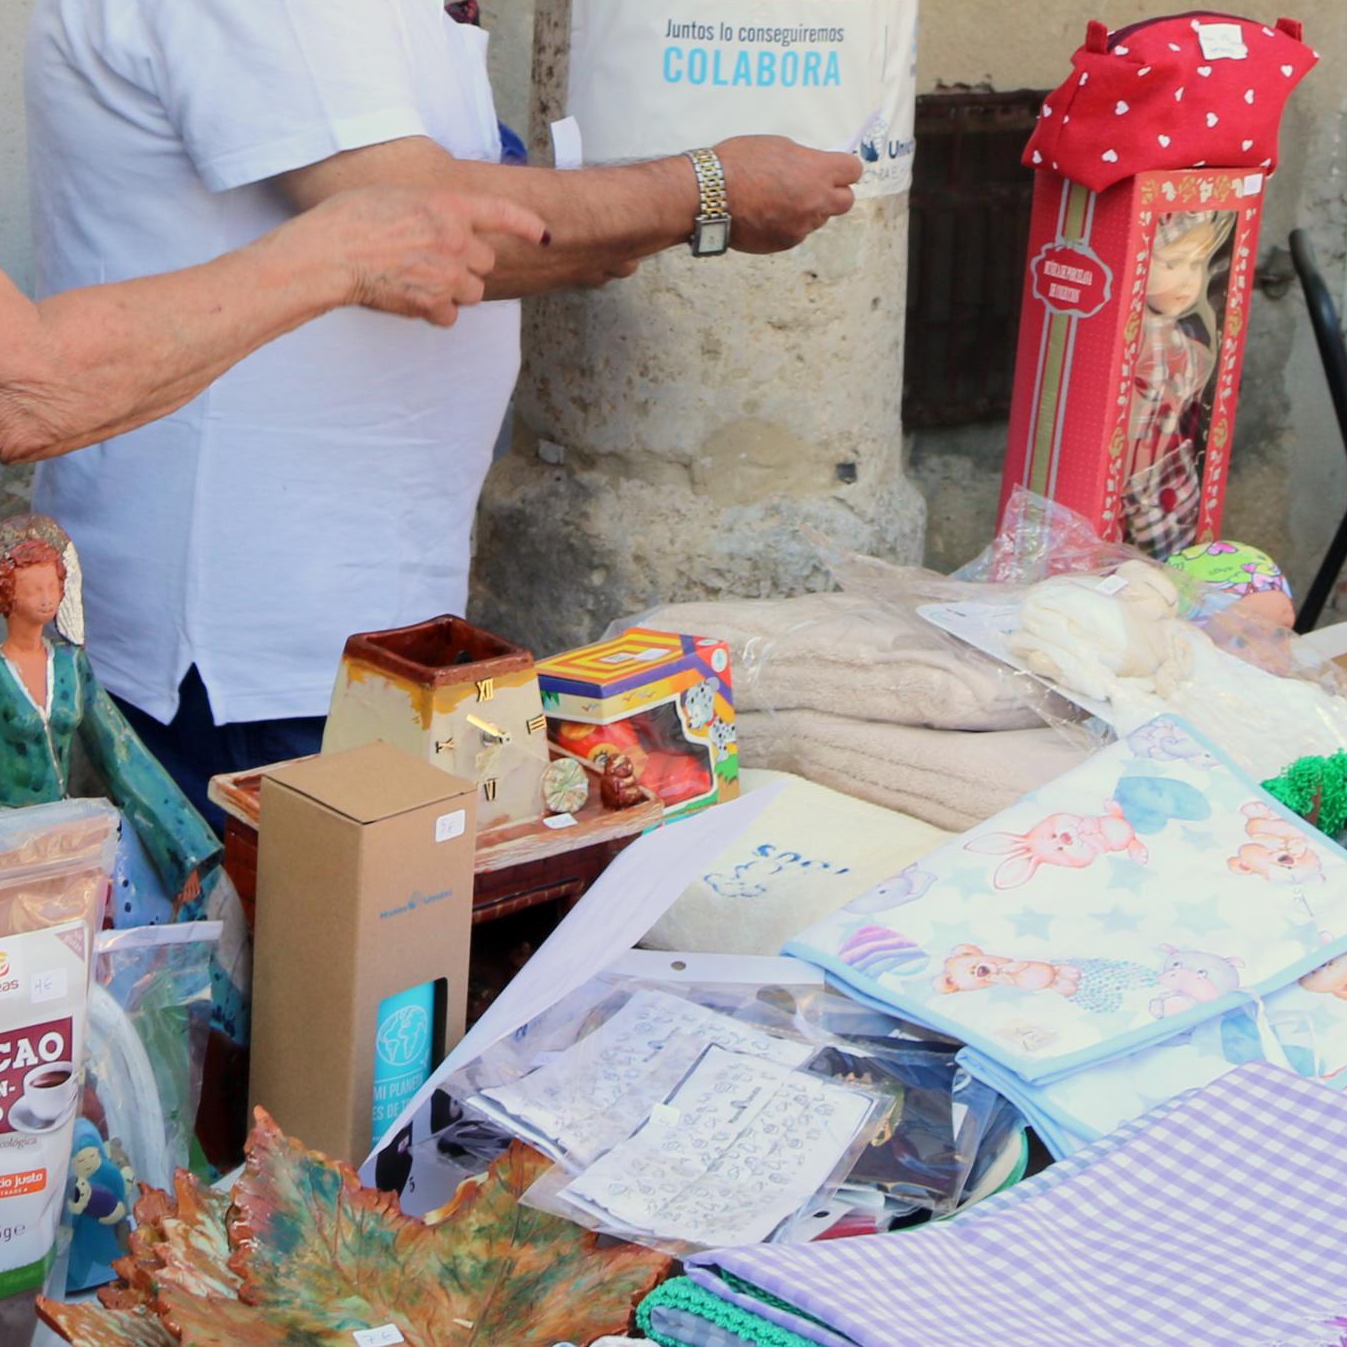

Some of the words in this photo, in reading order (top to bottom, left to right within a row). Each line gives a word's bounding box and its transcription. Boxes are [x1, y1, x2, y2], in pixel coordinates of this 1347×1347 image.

[666, 19, 714, 41] Juntos
[720, 22, 732, 41] lo
[738, 23, 844, 46] conseguiremos
[662, 46, 842, 87] COLABORA
[15, 1173, 43, 1185] justo
